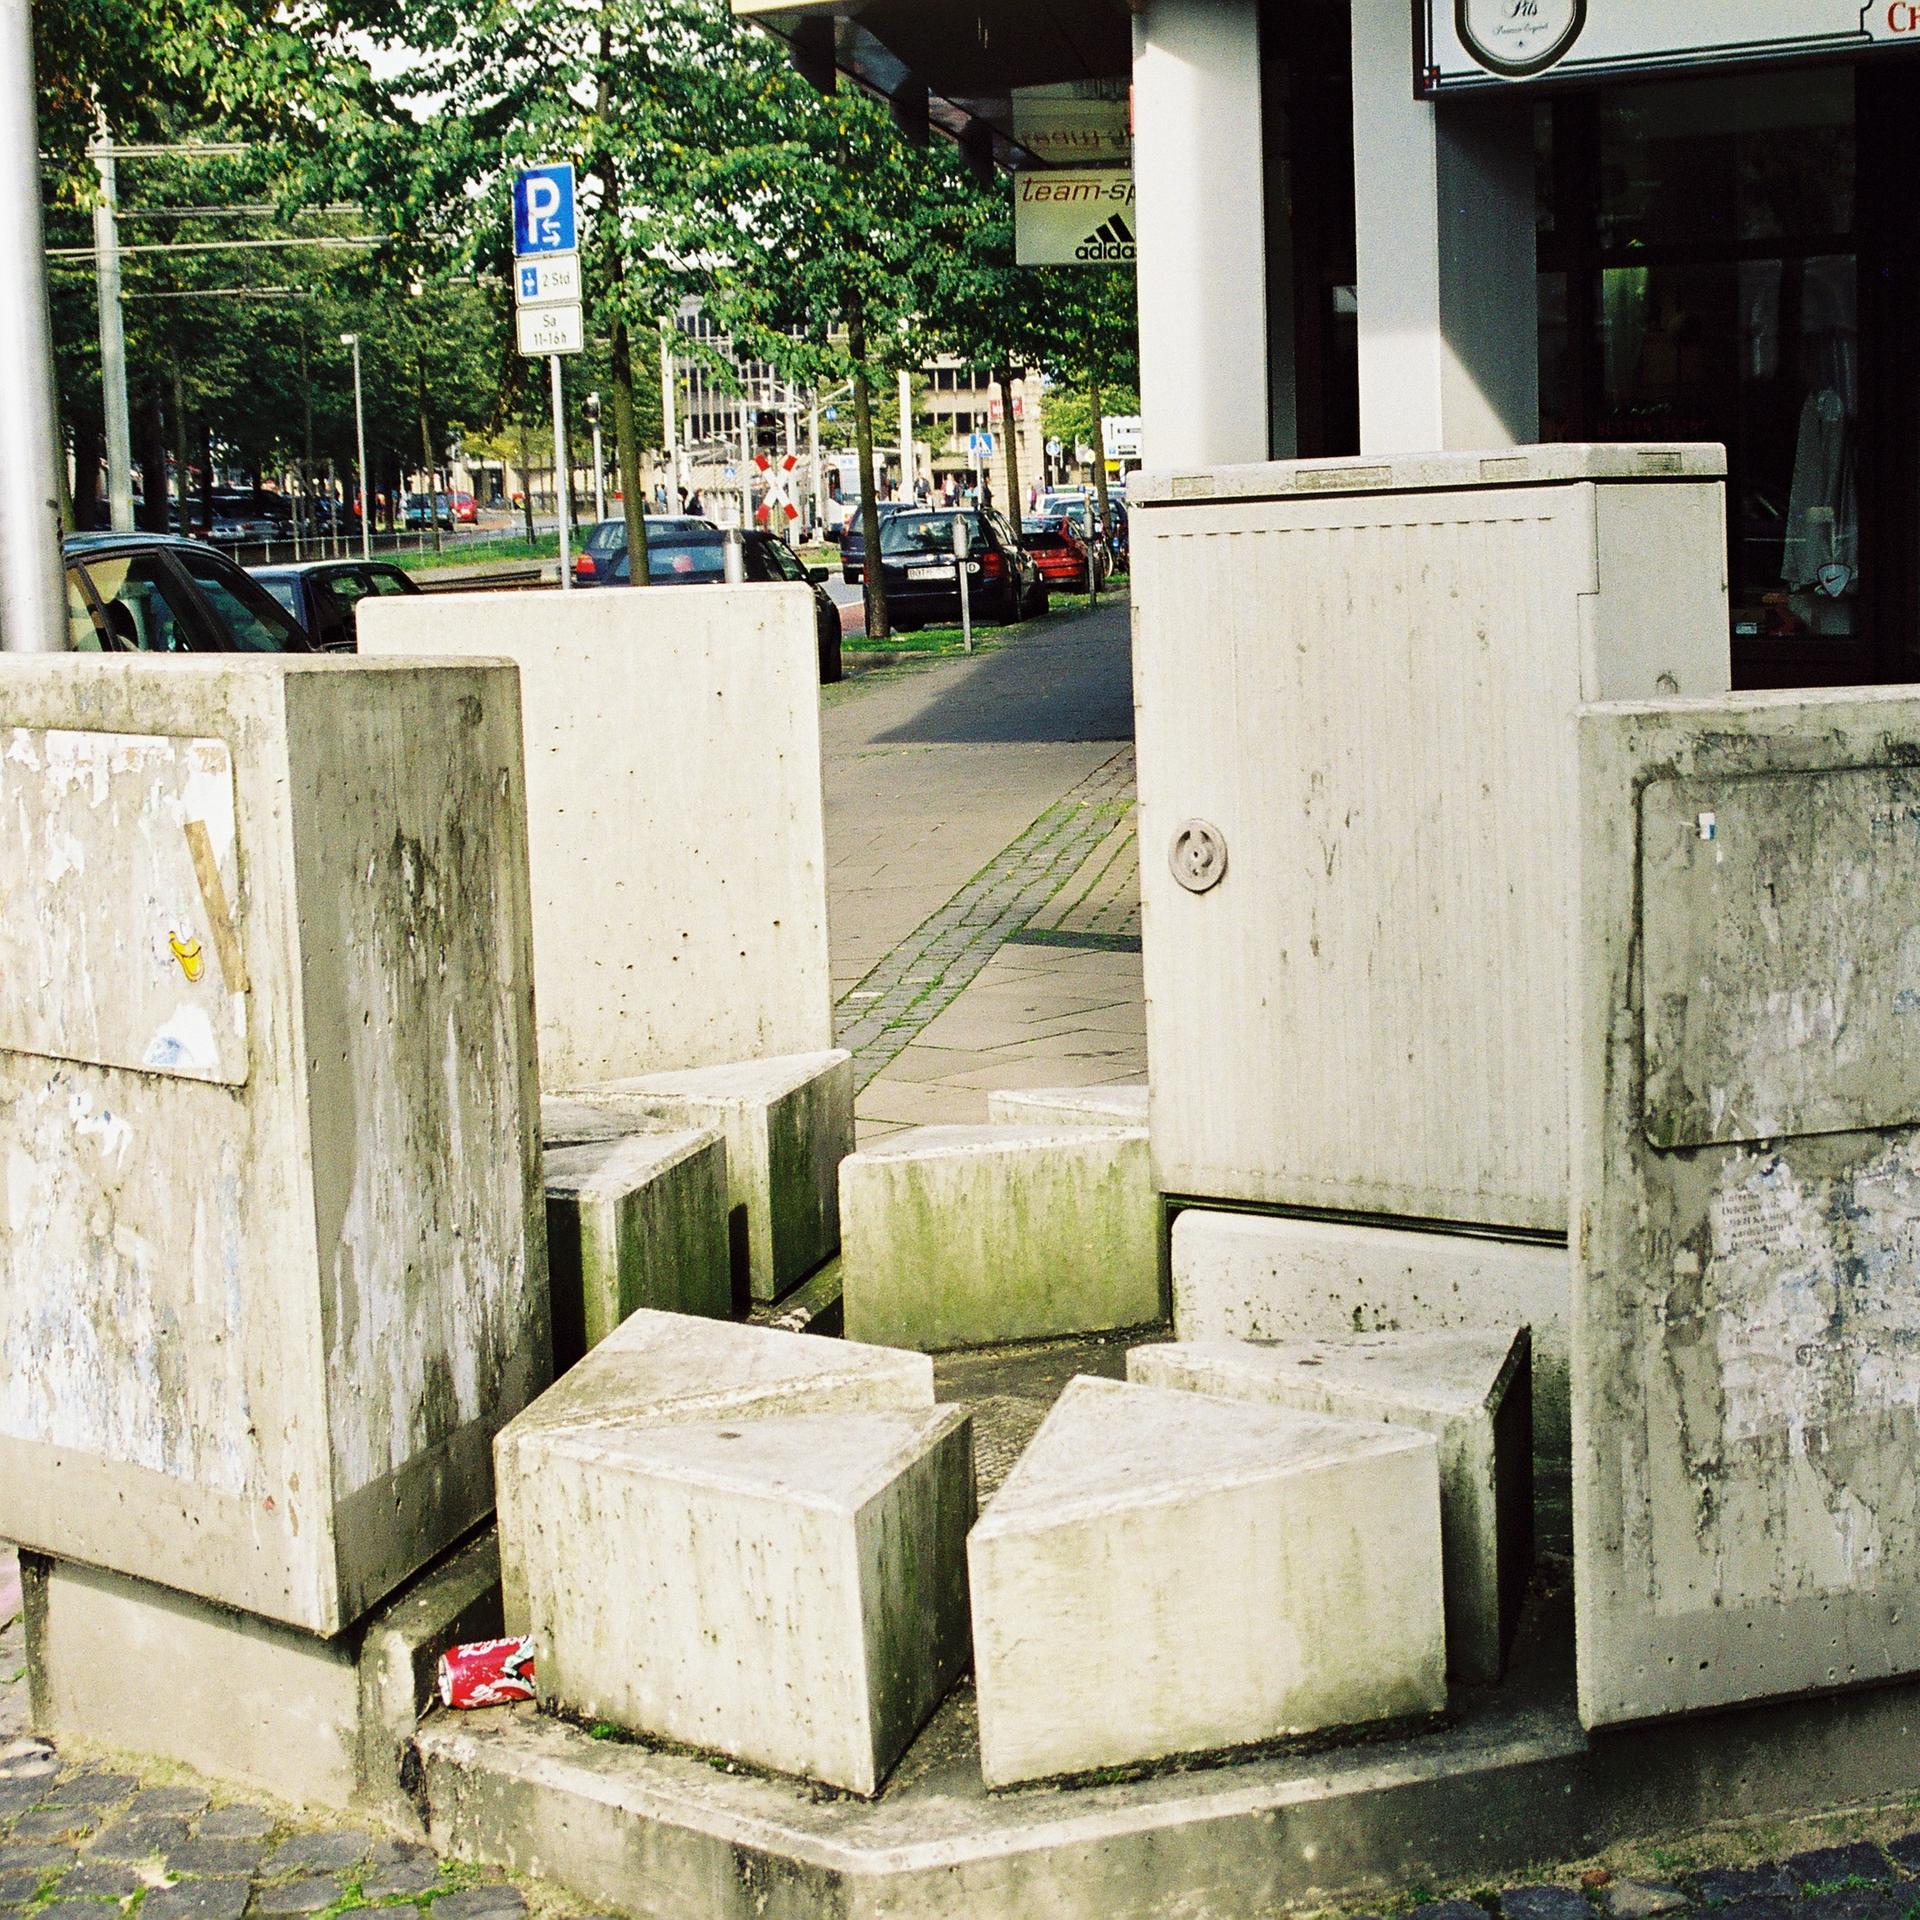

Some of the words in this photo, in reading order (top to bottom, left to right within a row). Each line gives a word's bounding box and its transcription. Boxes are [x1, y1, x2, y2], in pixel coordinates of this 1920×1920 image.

[526, 177, 560, 244] P
[1075, 242, 1137, 260] adida
[543, 273, 549, 287] 2
[551, 271, 570, 286] Std
[543, 314, 557, 328] Sa
